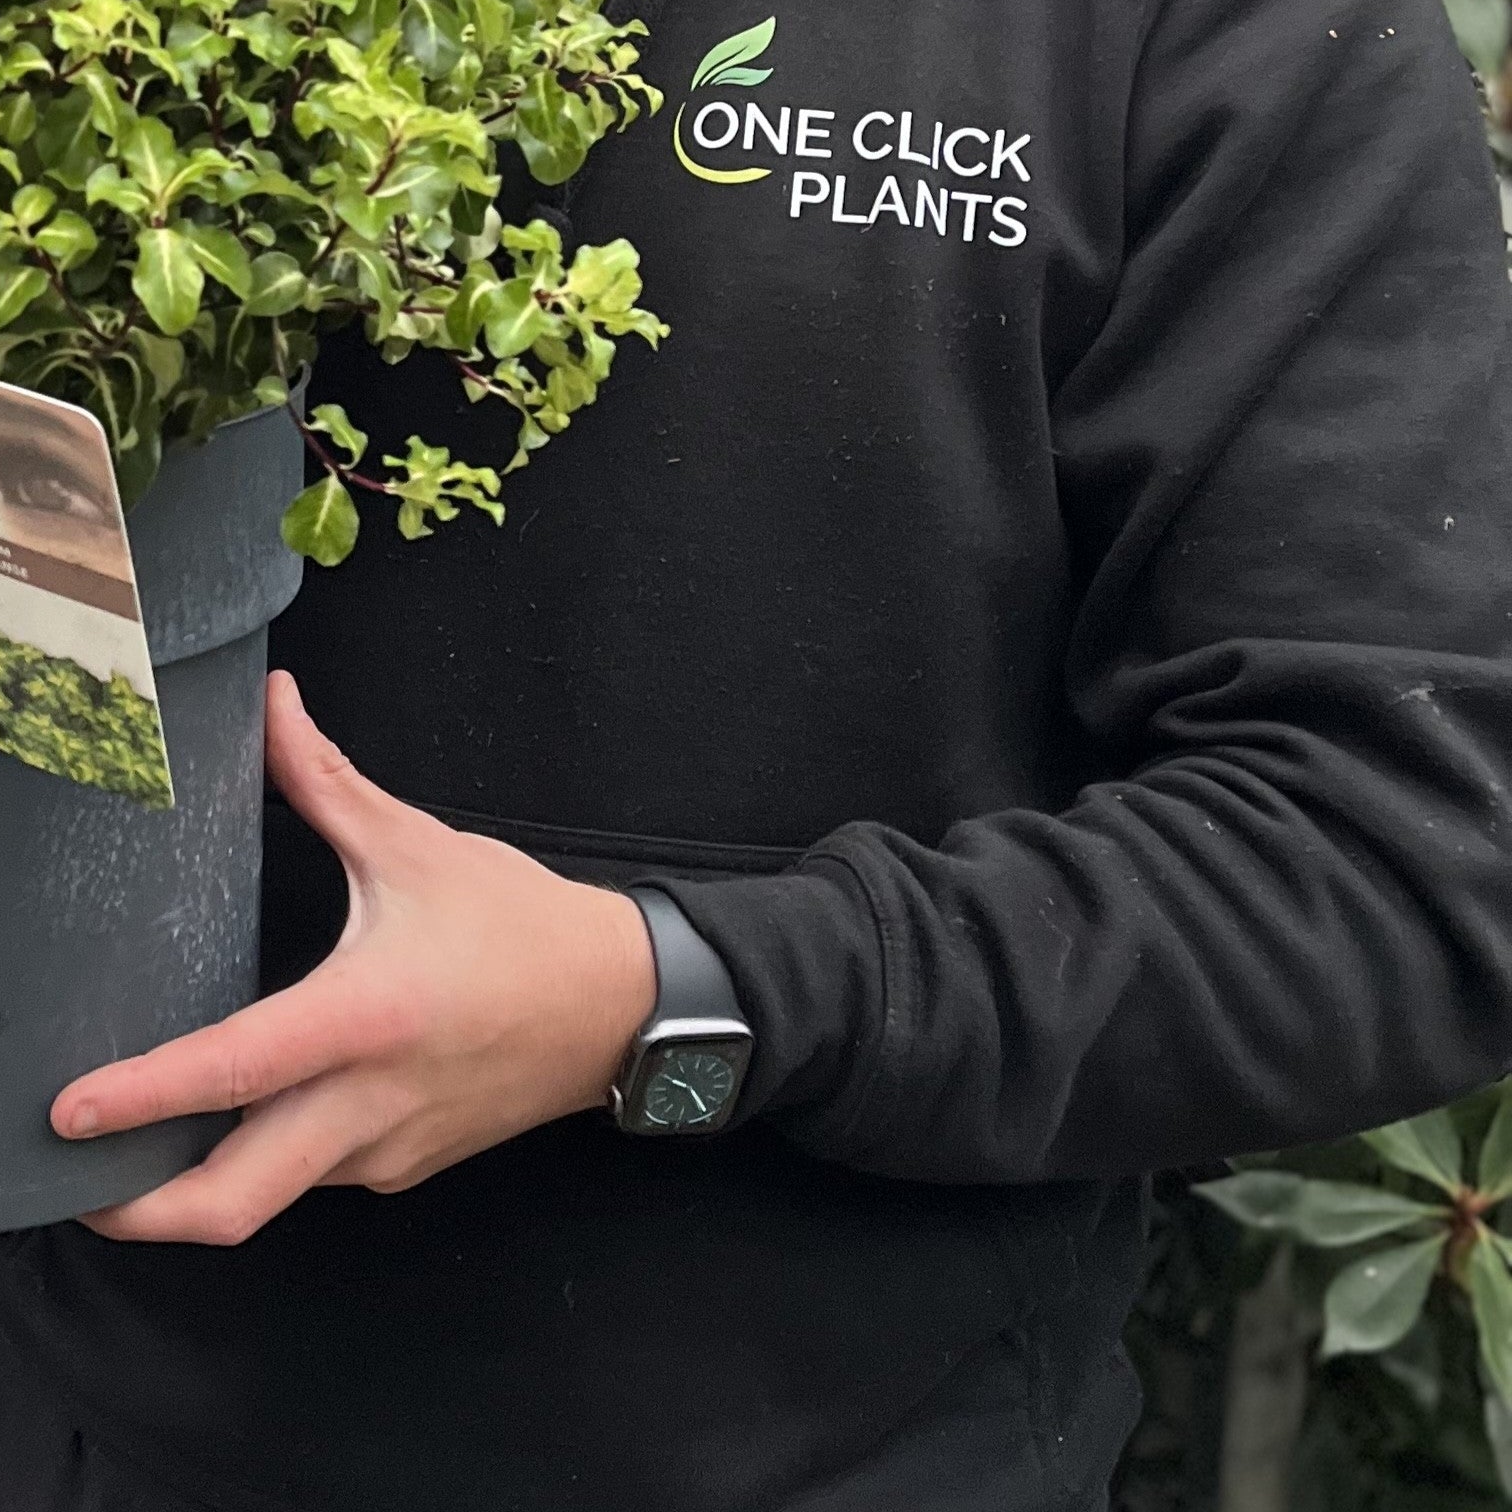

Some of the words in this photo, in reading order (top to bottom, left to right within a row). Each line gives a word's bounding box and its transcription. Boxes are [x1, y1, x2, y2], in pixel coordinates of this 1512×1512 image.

[693, 101, 835, 158] ONE
[852, 111, 1031, 182] CLICK
[790, 171, 1028, 247] PLANTS
